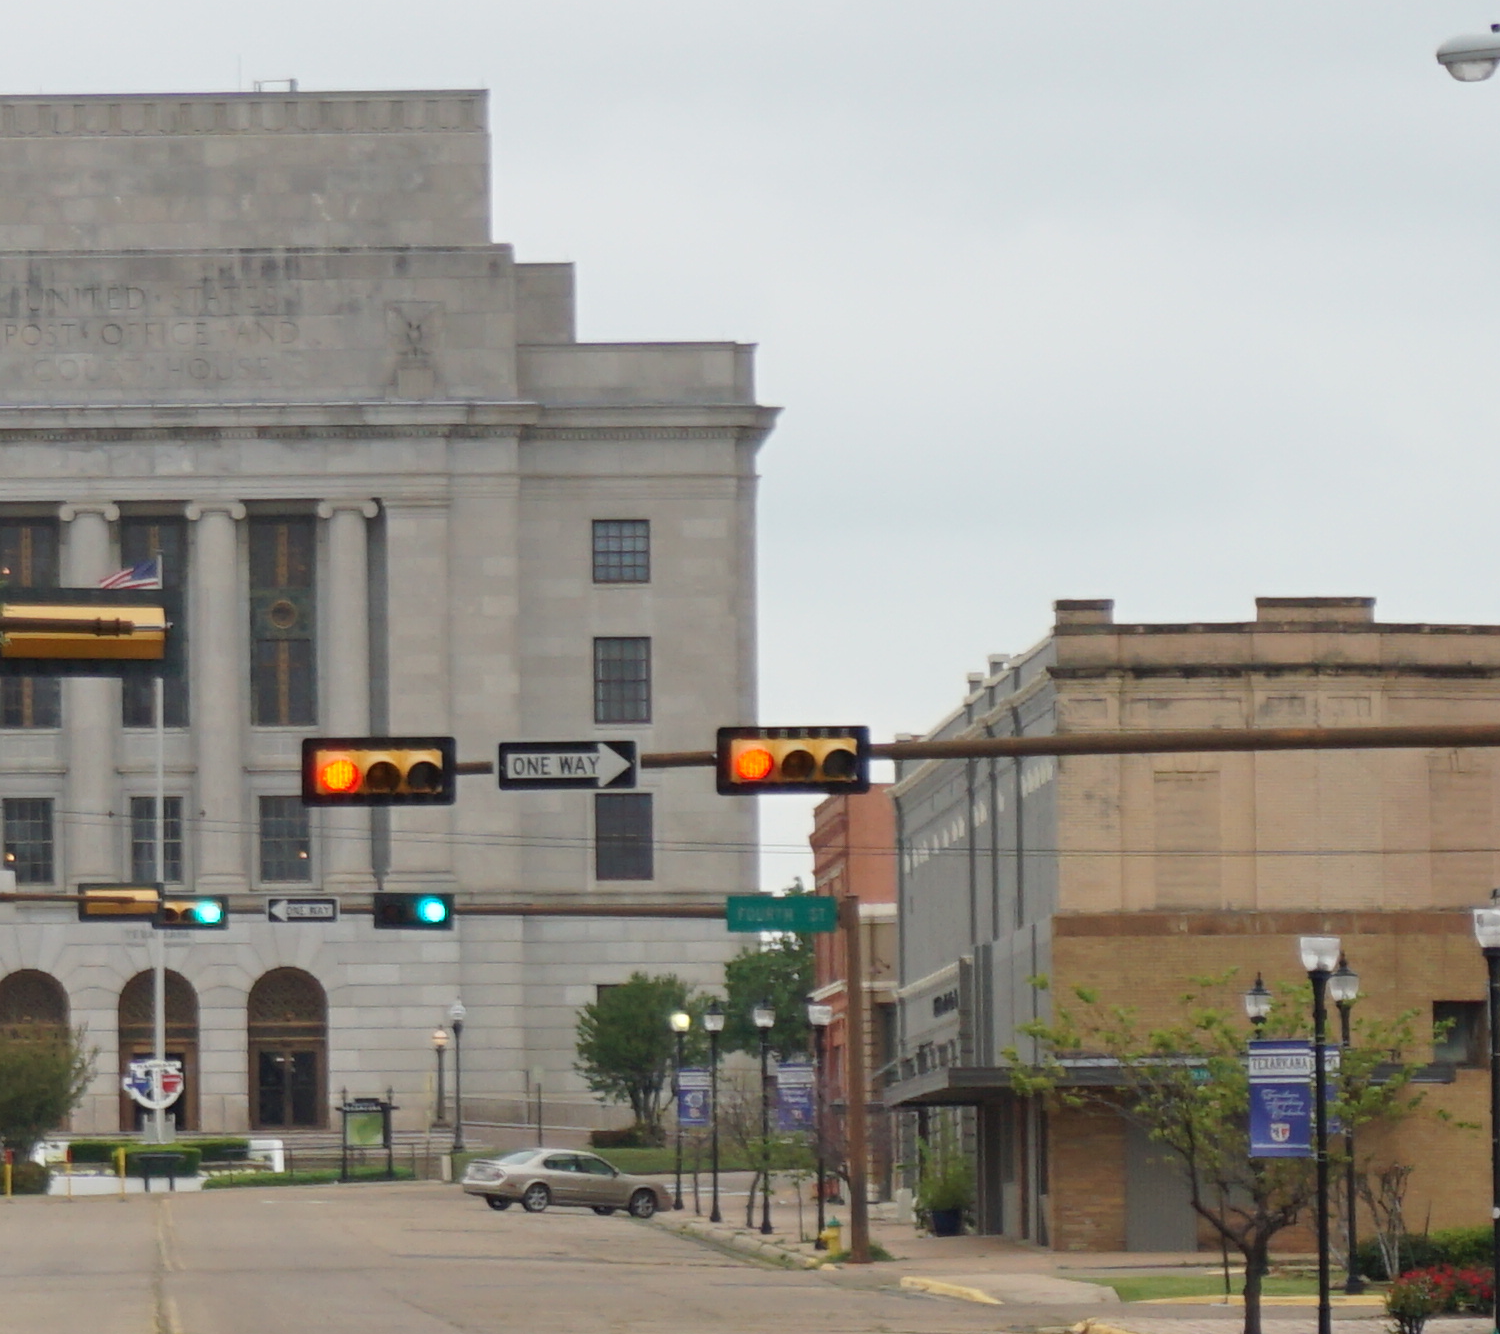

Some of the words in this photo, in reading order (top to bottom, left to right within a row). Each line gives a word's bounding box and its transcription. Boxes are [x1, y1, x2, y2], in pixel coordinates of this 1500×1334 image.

[25, 286, 146, 312] UNITED
[172, 286, 277, 310] STATES
[4, 322, 77, 347] POST
[101, 321, 209, 346] OFFICE
[236, 320, 300, 346] AND
[32, 357, 143, 382] COURT
[168, 357, 273, 382] HOUSE
[513, 756, 552, 776] ONE
[558, 755, 600, 776] WAY
[286, 906, 305, 916] ONE
[309, 906, 329, 916] WAY
[737, 907, 794, 922] FOURTH
[808, 907, 825, 922] ST
[1252, 1057, 1308, 1070] TEXARKANA
